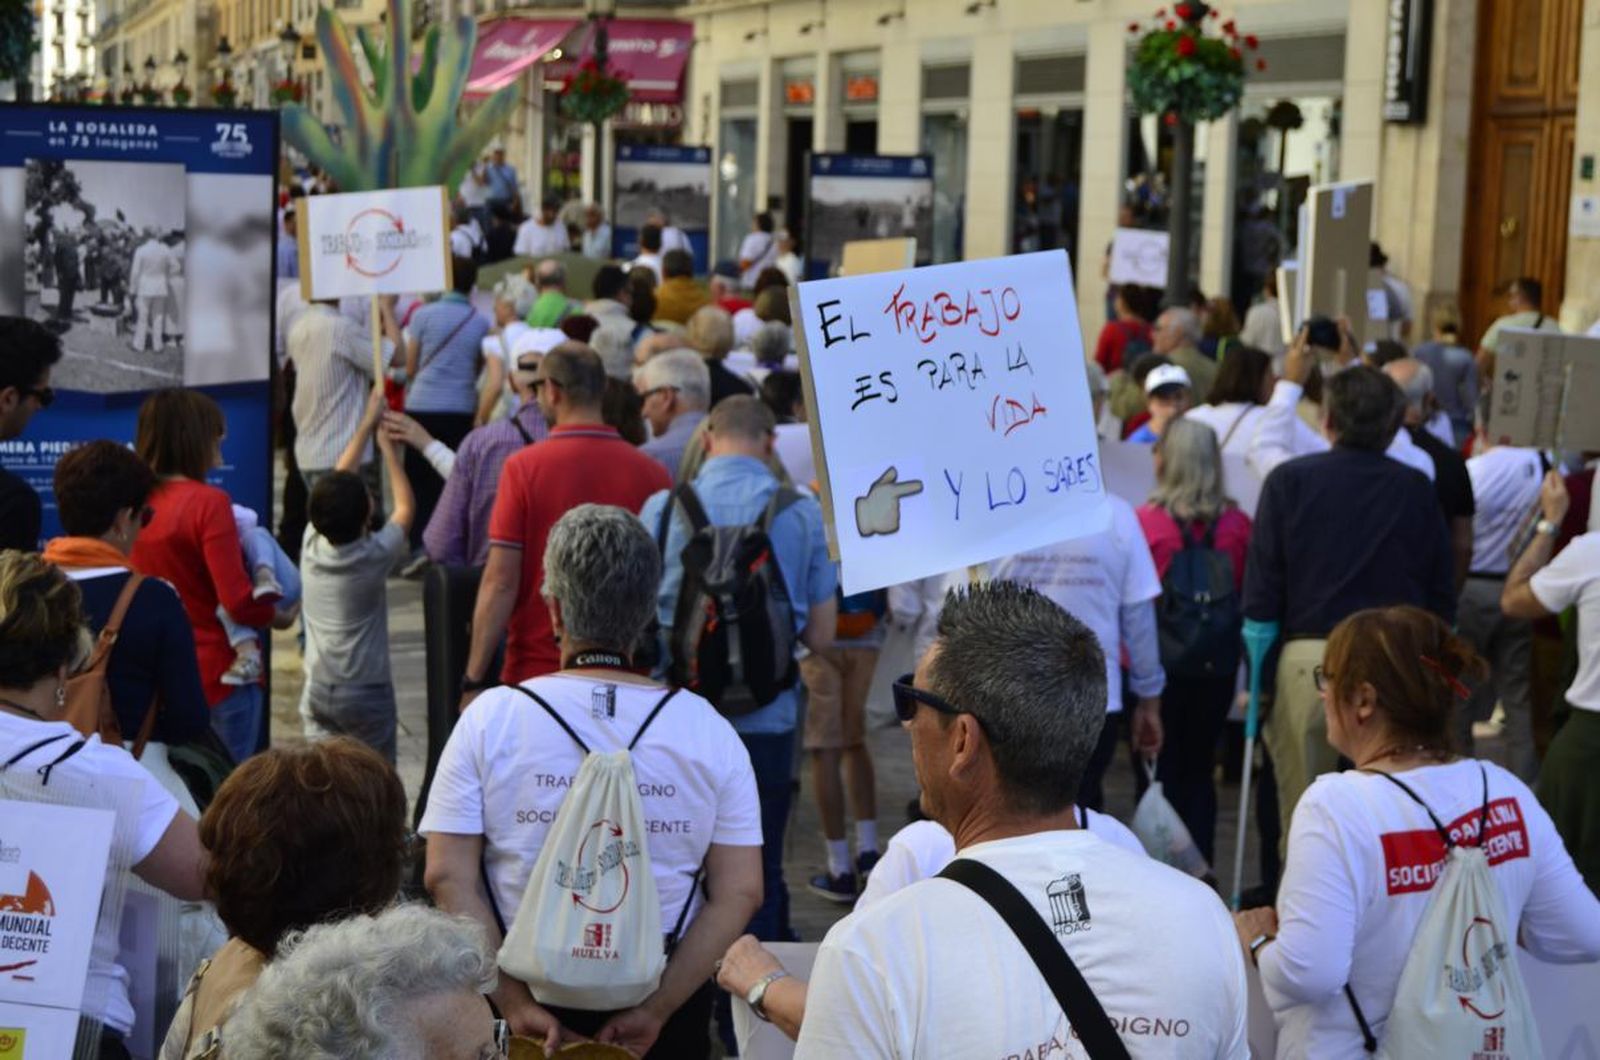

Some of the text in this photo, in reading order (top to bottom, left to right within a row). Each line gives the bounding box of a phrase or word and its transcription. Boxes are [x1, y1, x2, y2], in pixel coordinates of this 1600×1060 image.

[49, 121, 158, 136] LA ROSALEDA
[216, 123, 252, 143] 75
[71, 135, 89, 147] 75
[816, 282, 1021, 348] EL TRABAJO
[851, 341, 1034, 411] ES PARA LA
[984, 391, 1048, 437] VIDA
[943, 451, 1100, 521] Y LO SABES
[575, 653, 621, 666] Canon
[2, 934, 50, 953] DECENTE
[571, 946, 620, 960] HUELVA
